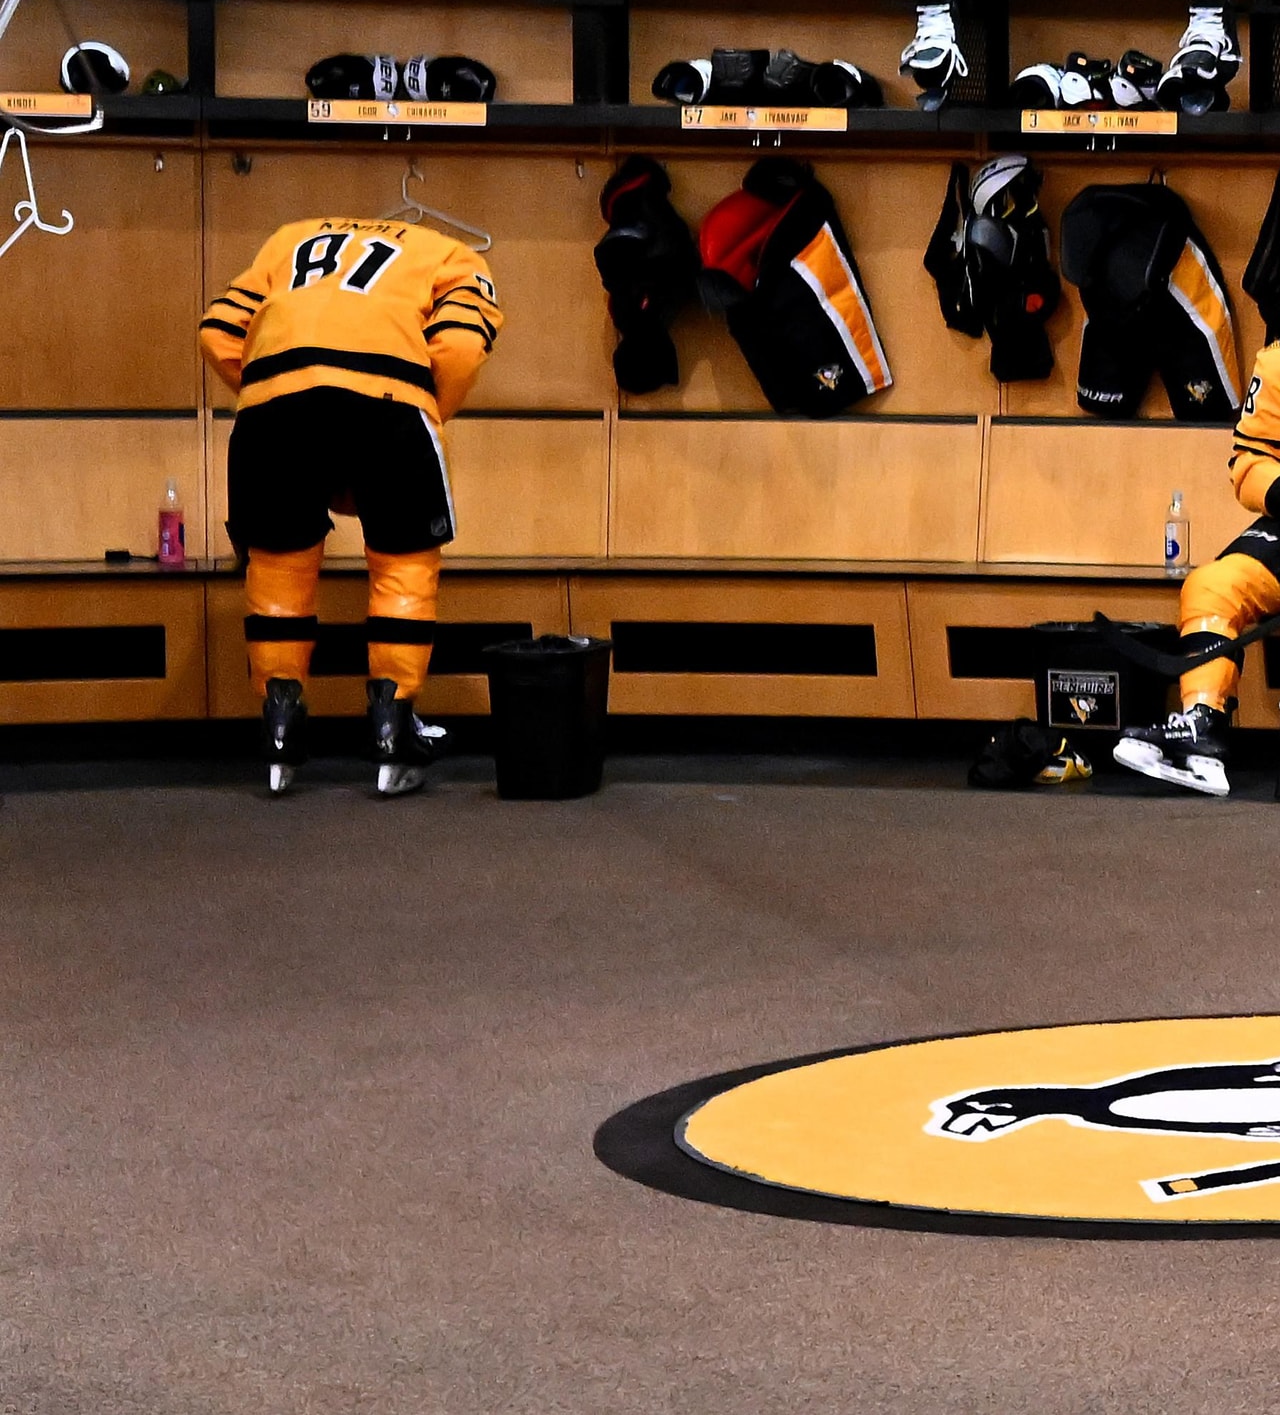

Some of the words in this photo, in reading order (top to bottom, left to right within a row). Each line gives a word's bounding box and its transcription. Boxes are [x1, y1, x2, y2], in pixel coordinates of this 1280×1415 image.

[310, 101, 332, 118] 59
[684, 107, 703, 125] 57
[1062, 115, 1081, 127] JACK
[1051, 680, 1116, 696] PENGUINS
